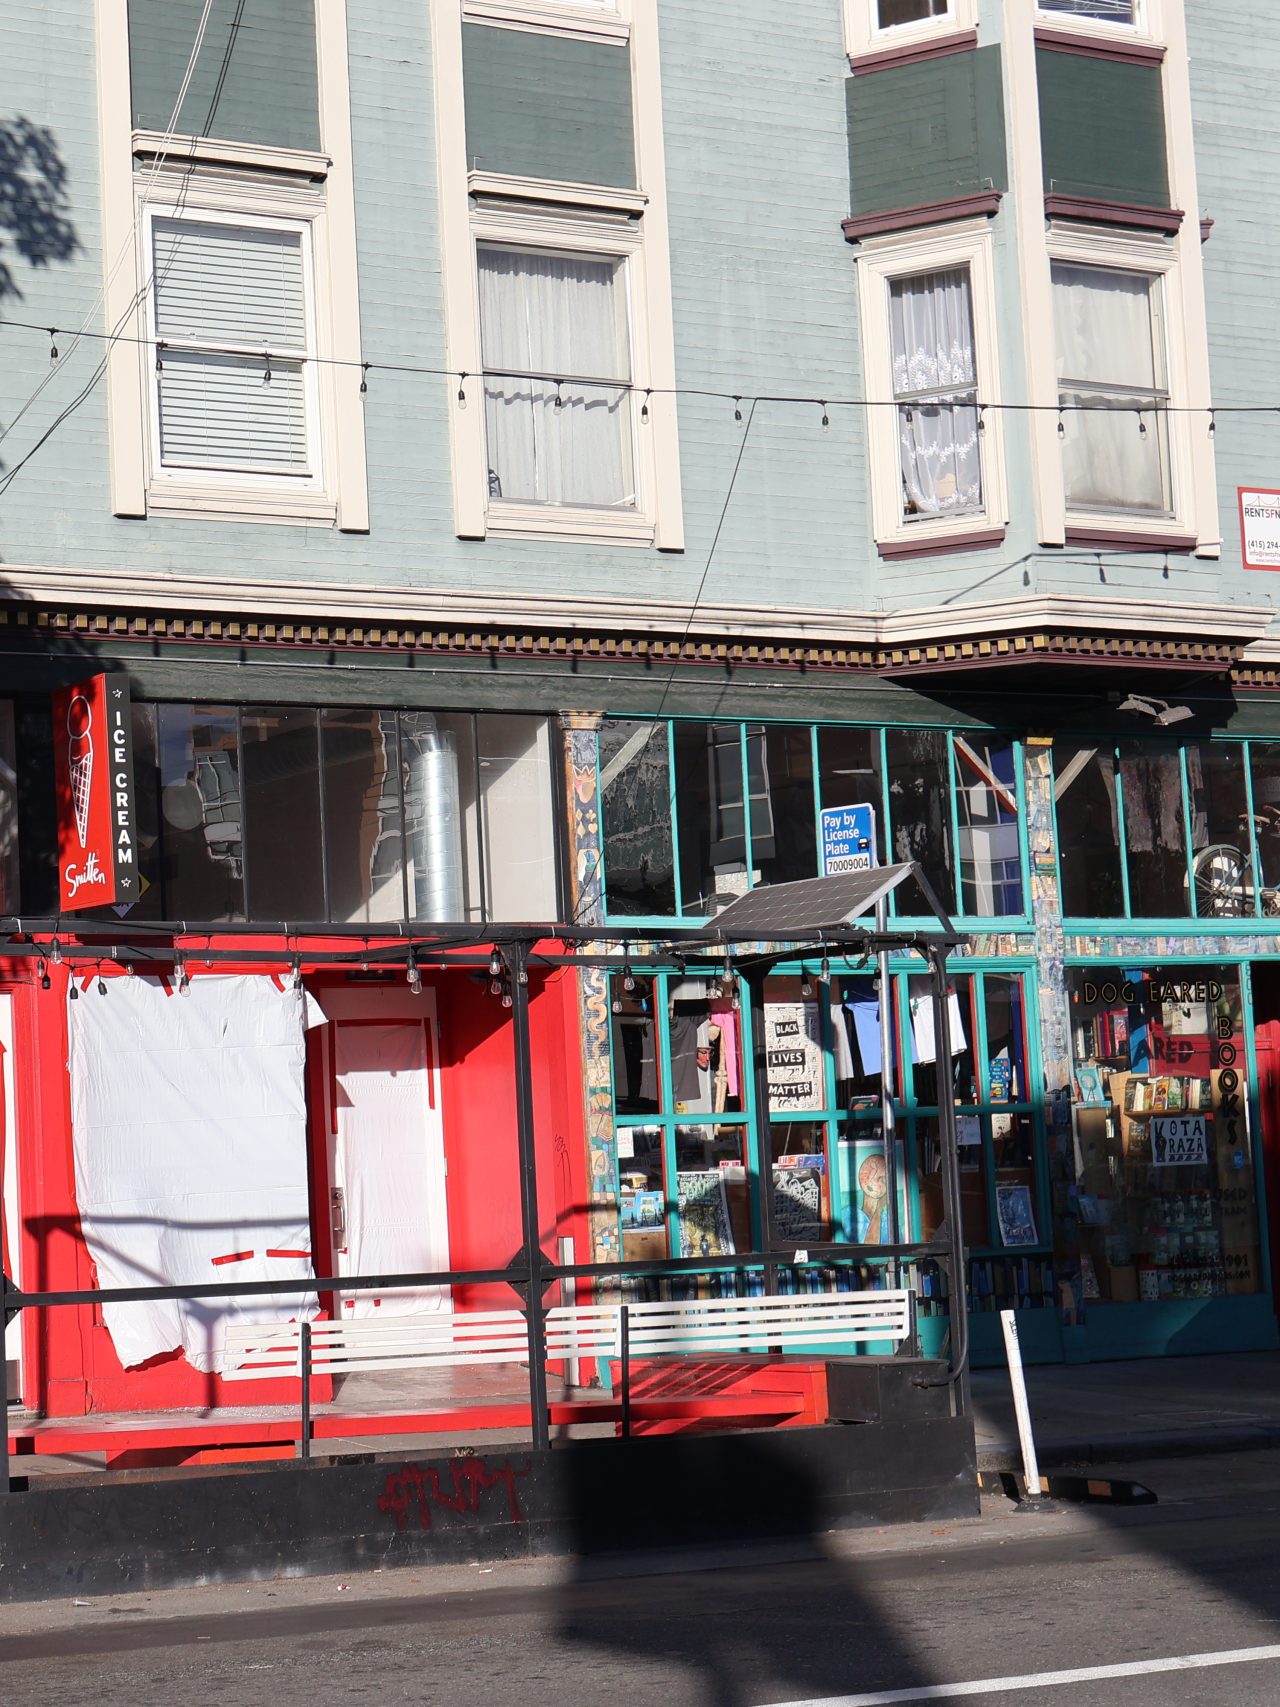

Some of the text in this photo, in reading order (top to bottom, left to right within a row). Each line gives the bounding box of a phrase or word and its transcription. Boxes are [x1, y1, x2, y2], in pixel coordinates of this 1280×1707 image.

[113, 711, 132, 864] ICE CREAM
[824, 812, 856, 829] Pay by
[825, 828, 859, 842] License
[826, 842, 849, 856] Plate
[828, 857, 868, 872] 70009004
[65, 852, 105, 897] Smitten
[1084, 980, 1223, 1003] DOG EARED
[776, 1023, 798, 1034] BLACK
[772, 1052, 803, 1064] LIVES
[1218, 1016, 1240, 1145] BOOKS
[768, 1084, 811, 1095] MATTER
[1169, 1138, 1204, 1153] RAZA
